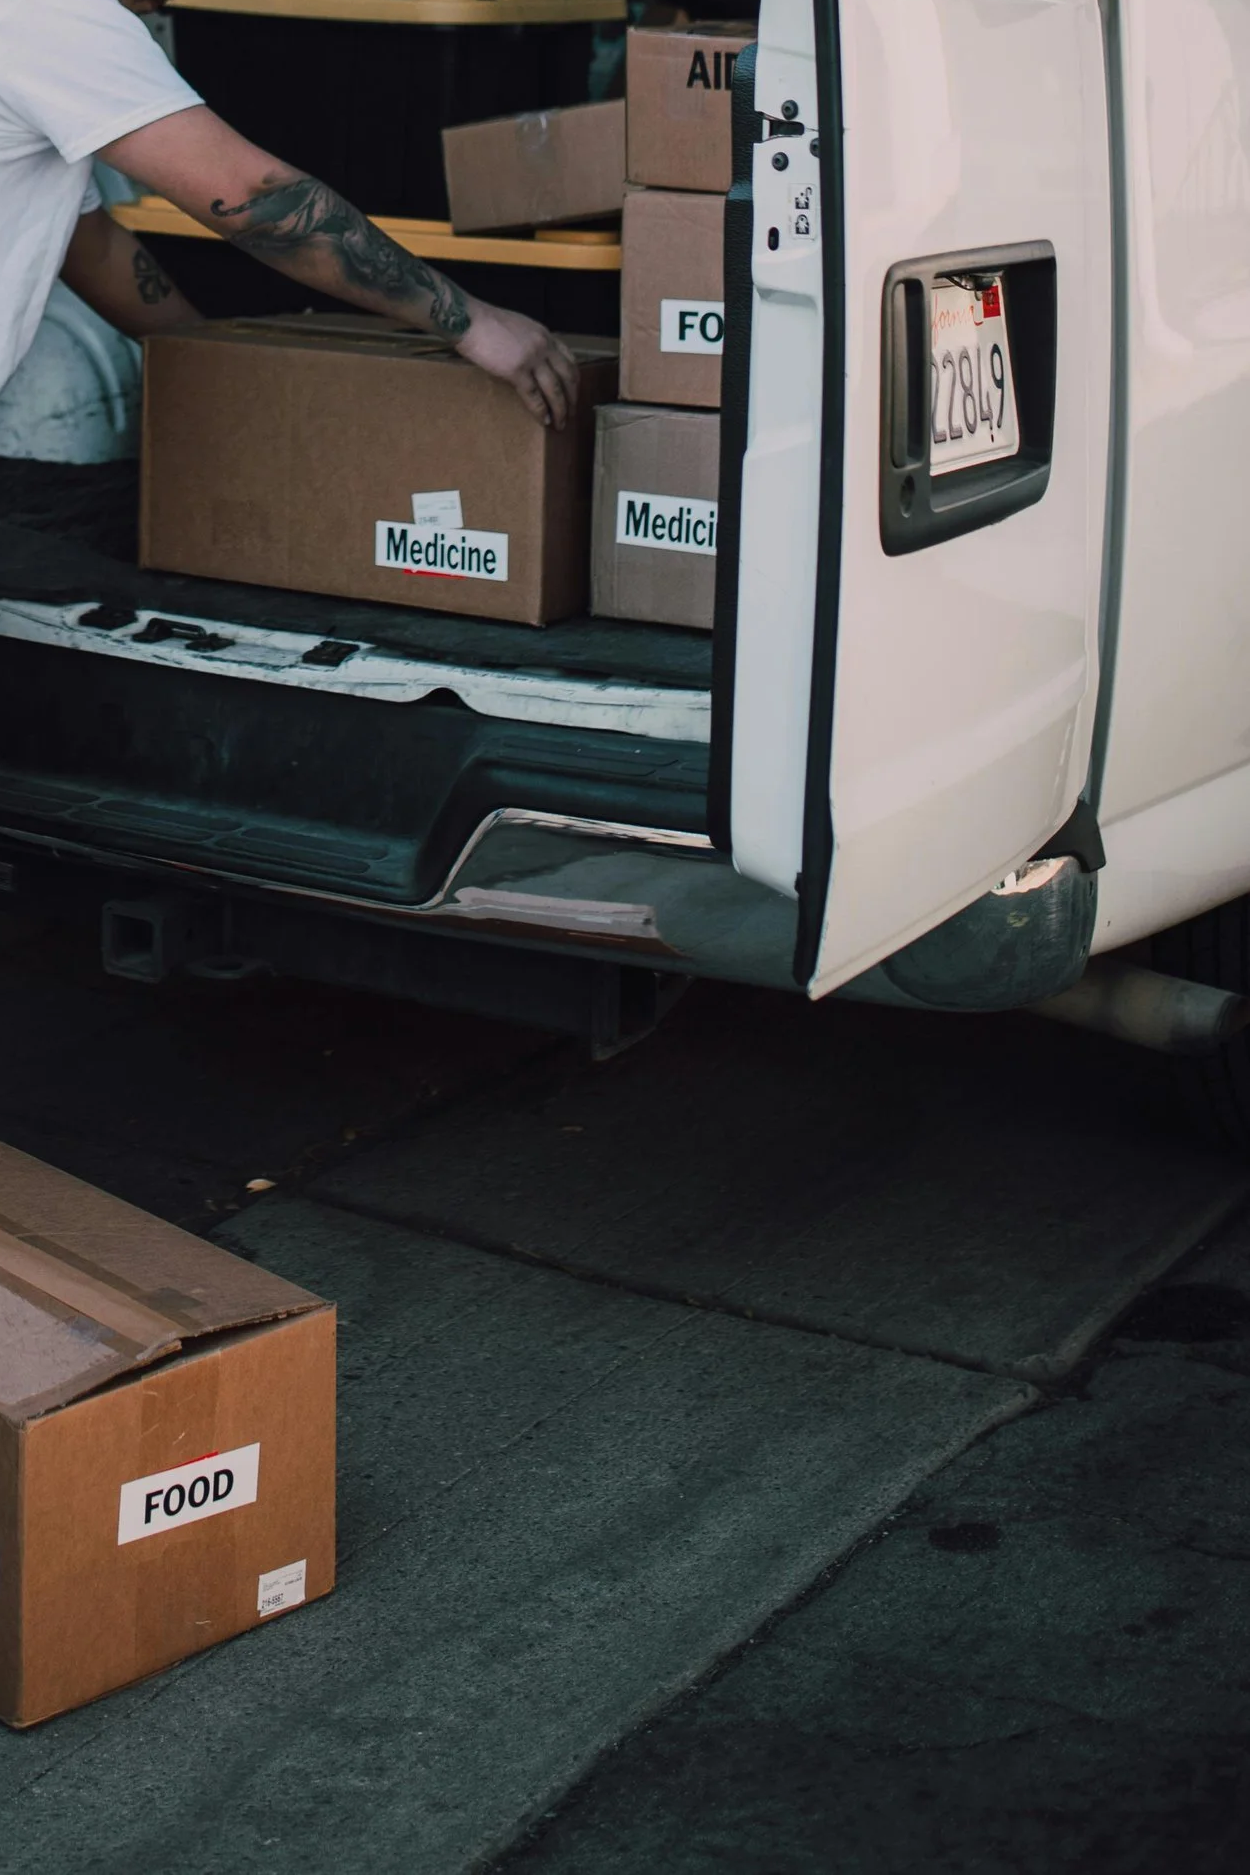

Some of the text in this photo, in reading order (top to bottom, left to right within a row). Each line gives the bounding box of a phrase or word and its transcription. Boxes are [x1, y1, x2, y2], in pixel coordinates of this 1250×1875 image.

[678, 311, 724, 343] FO
[930, 343, 1005, 444] 22849
[625, 500, 715, 547] Medici
[386, 527, 497, 574] Medicine
[144, 1468, 234, 1524] FOOD
